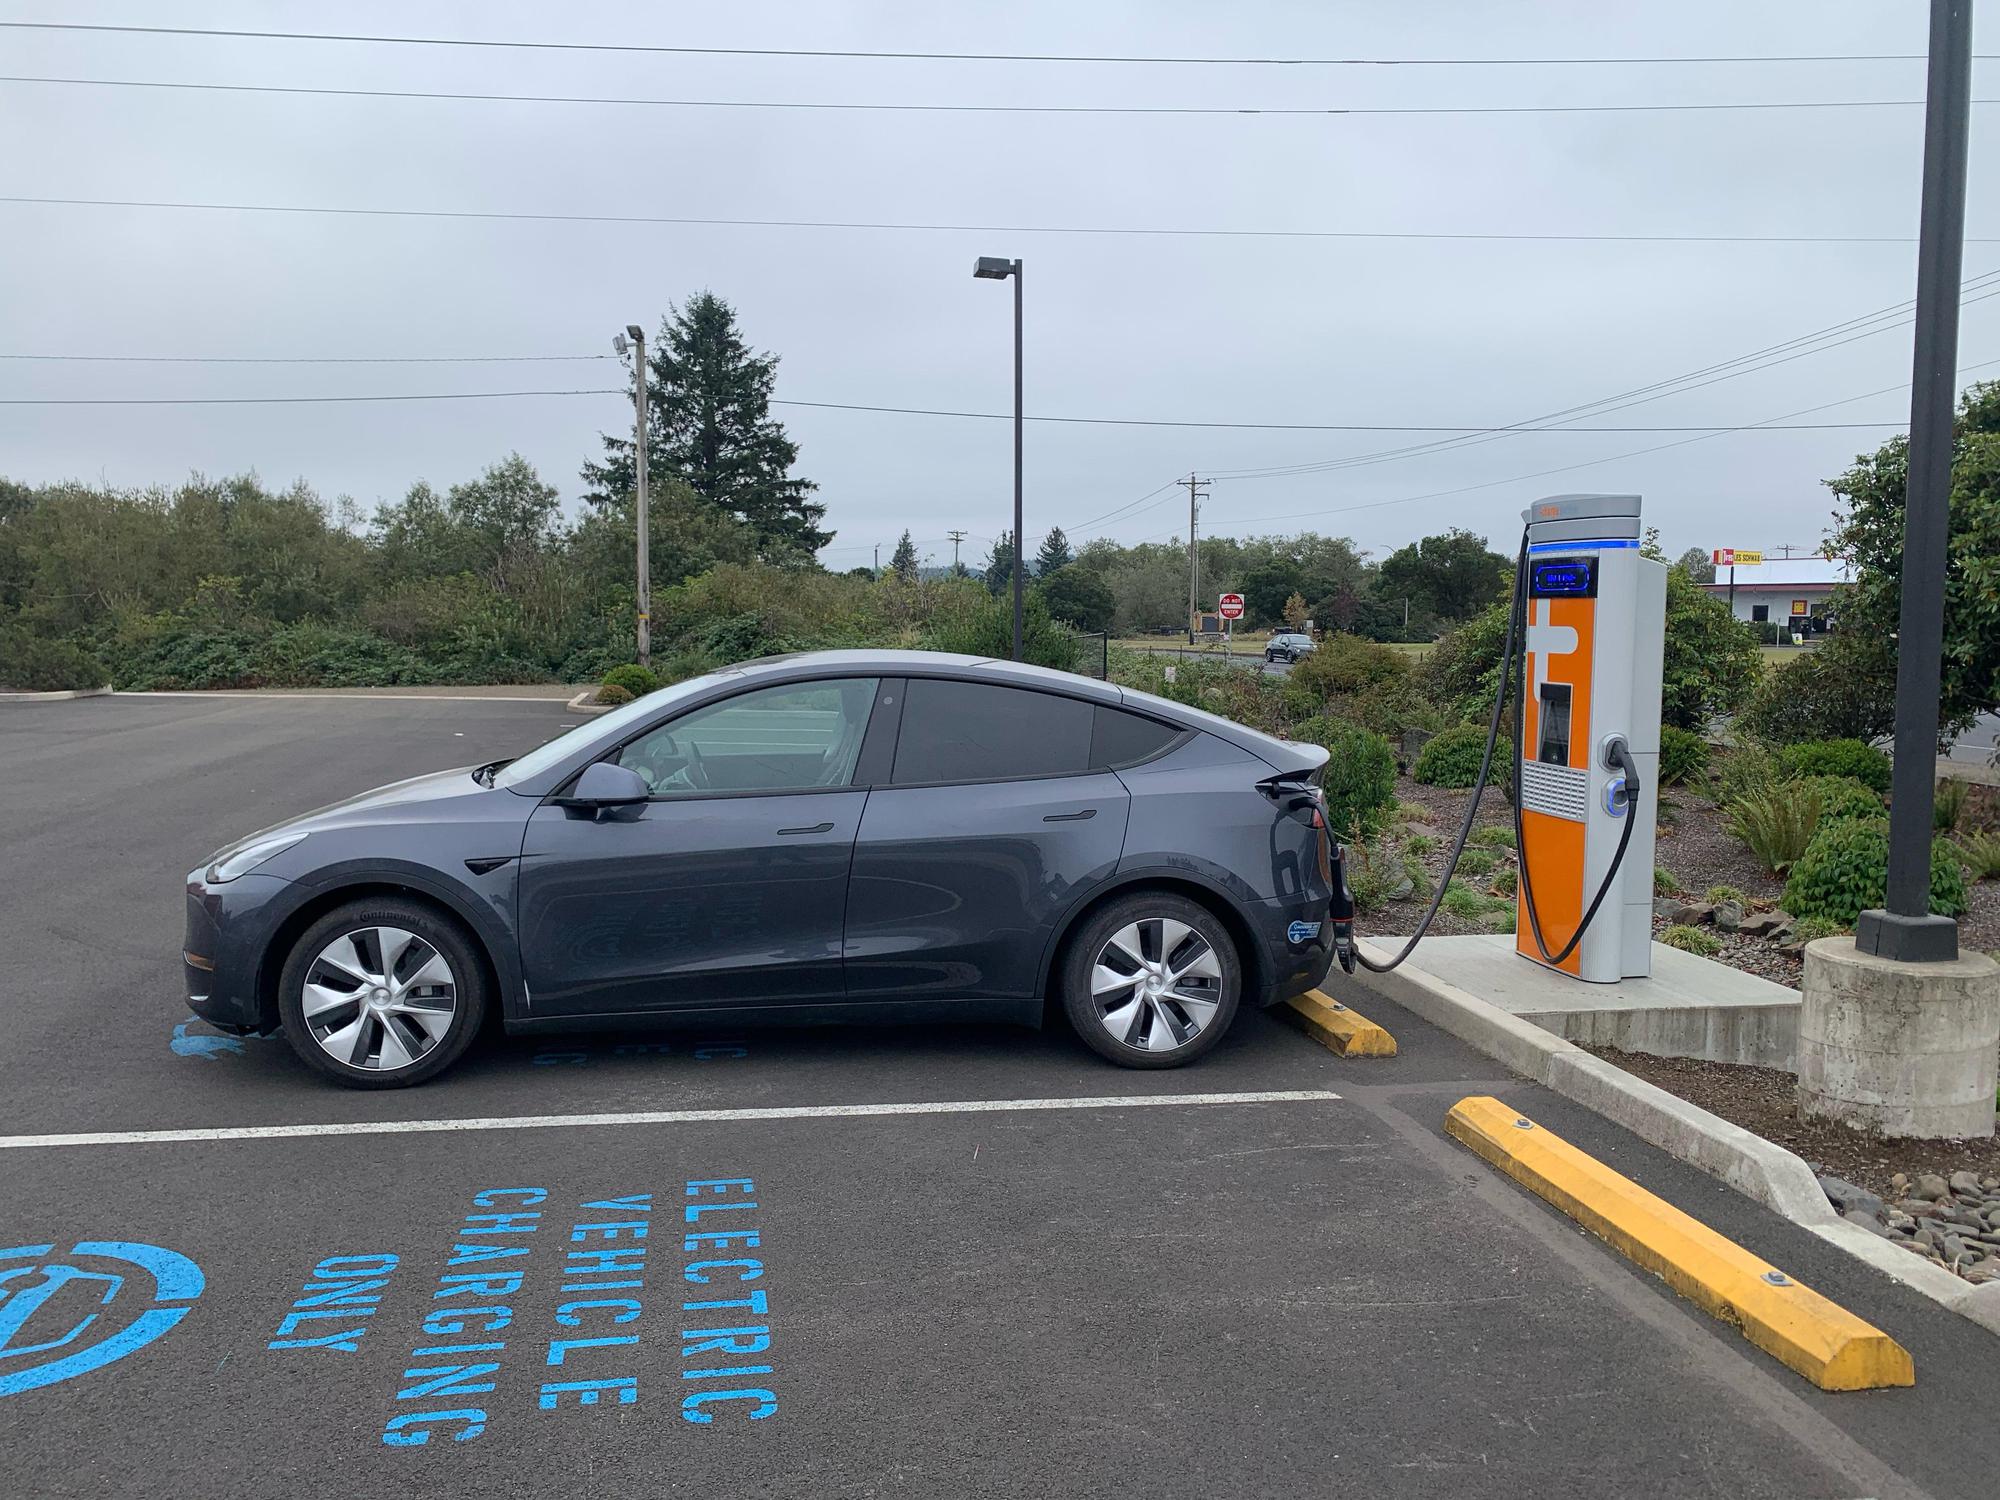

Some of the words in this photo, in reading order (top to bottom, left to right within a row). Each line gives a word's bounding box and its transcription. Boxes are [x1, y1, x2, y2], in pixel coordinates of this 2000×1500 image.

[360, 910, 421, 927] Continental
[267, 1252, 401, 1353] ONLY
[381, 1186, 549, 1447] CHARGING
[539, 1193, 654, 1410] VEHICLE
[681, 1177, 779, 1424] ELECTRIC
